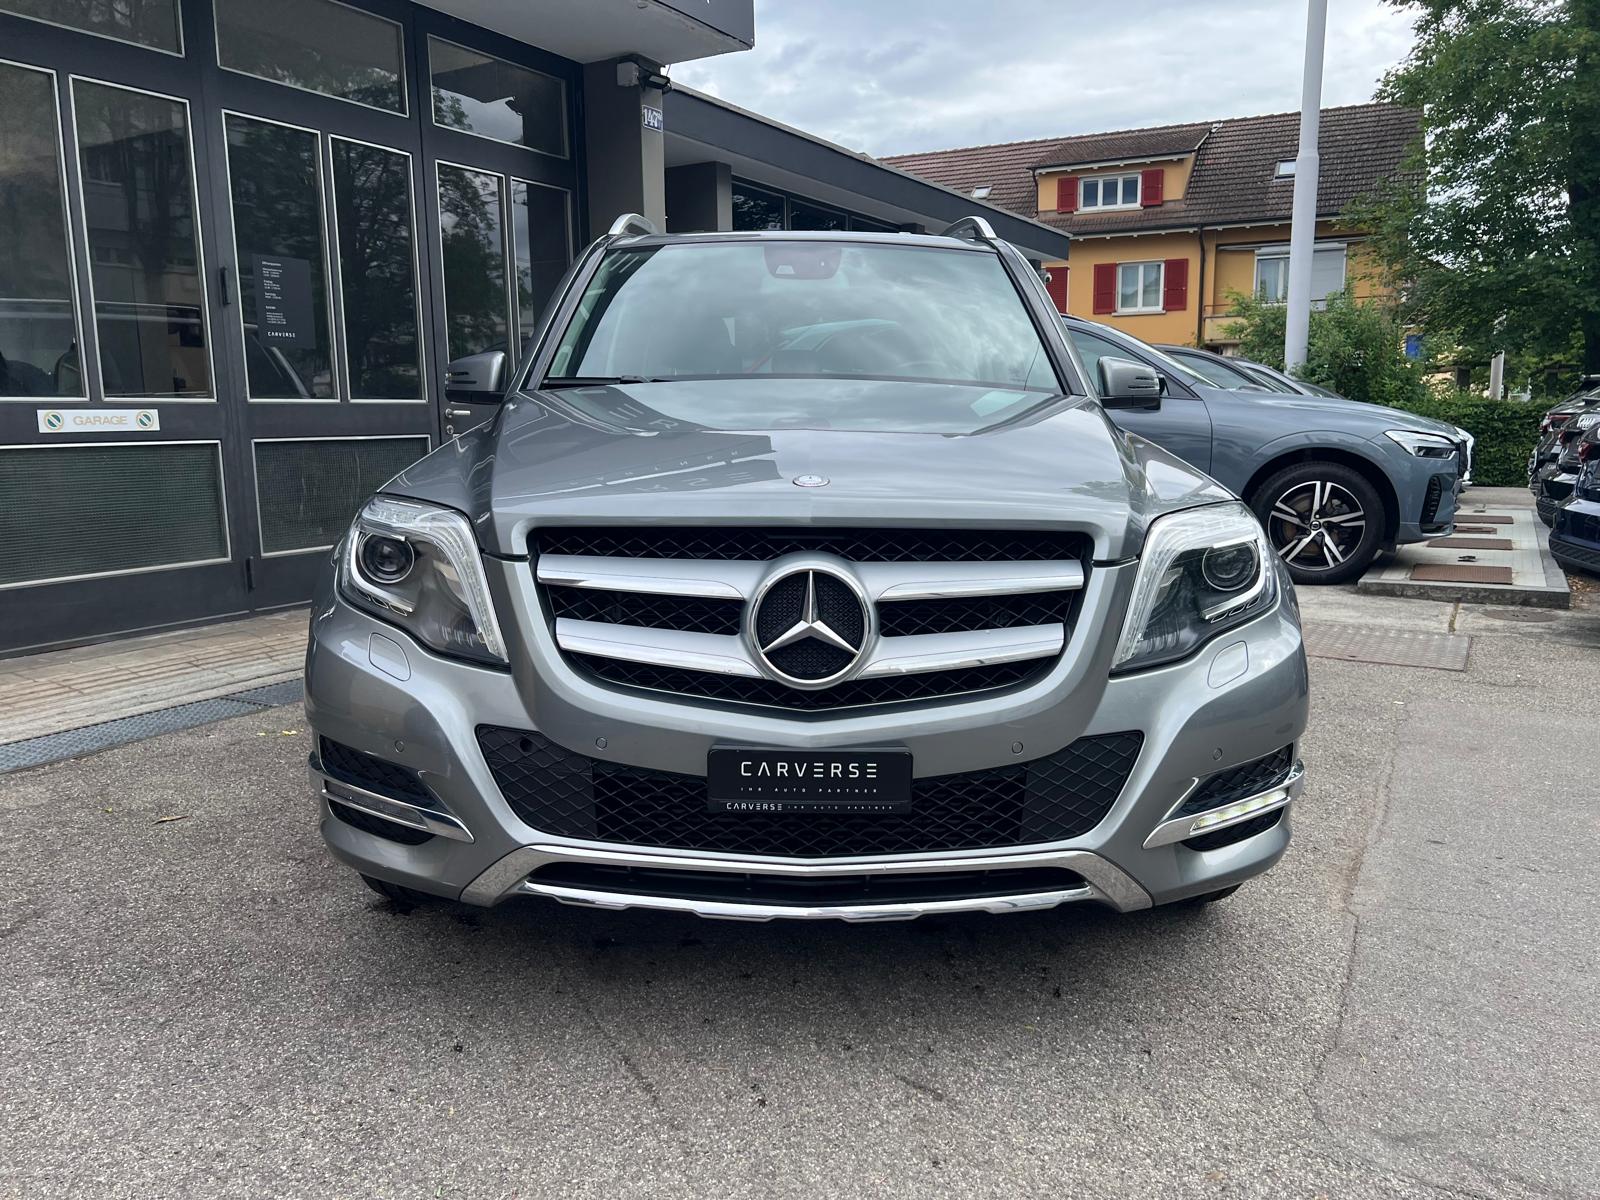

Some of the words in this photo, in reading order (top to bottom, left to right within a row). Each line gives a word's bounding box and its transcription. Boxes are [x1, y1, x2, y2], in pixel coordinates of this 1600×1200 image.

[73, 415, 128, 426] GARAGE
[740, 761, 878, 778] CARVERSE
[726, 802, 783, 811] CARVERSE
